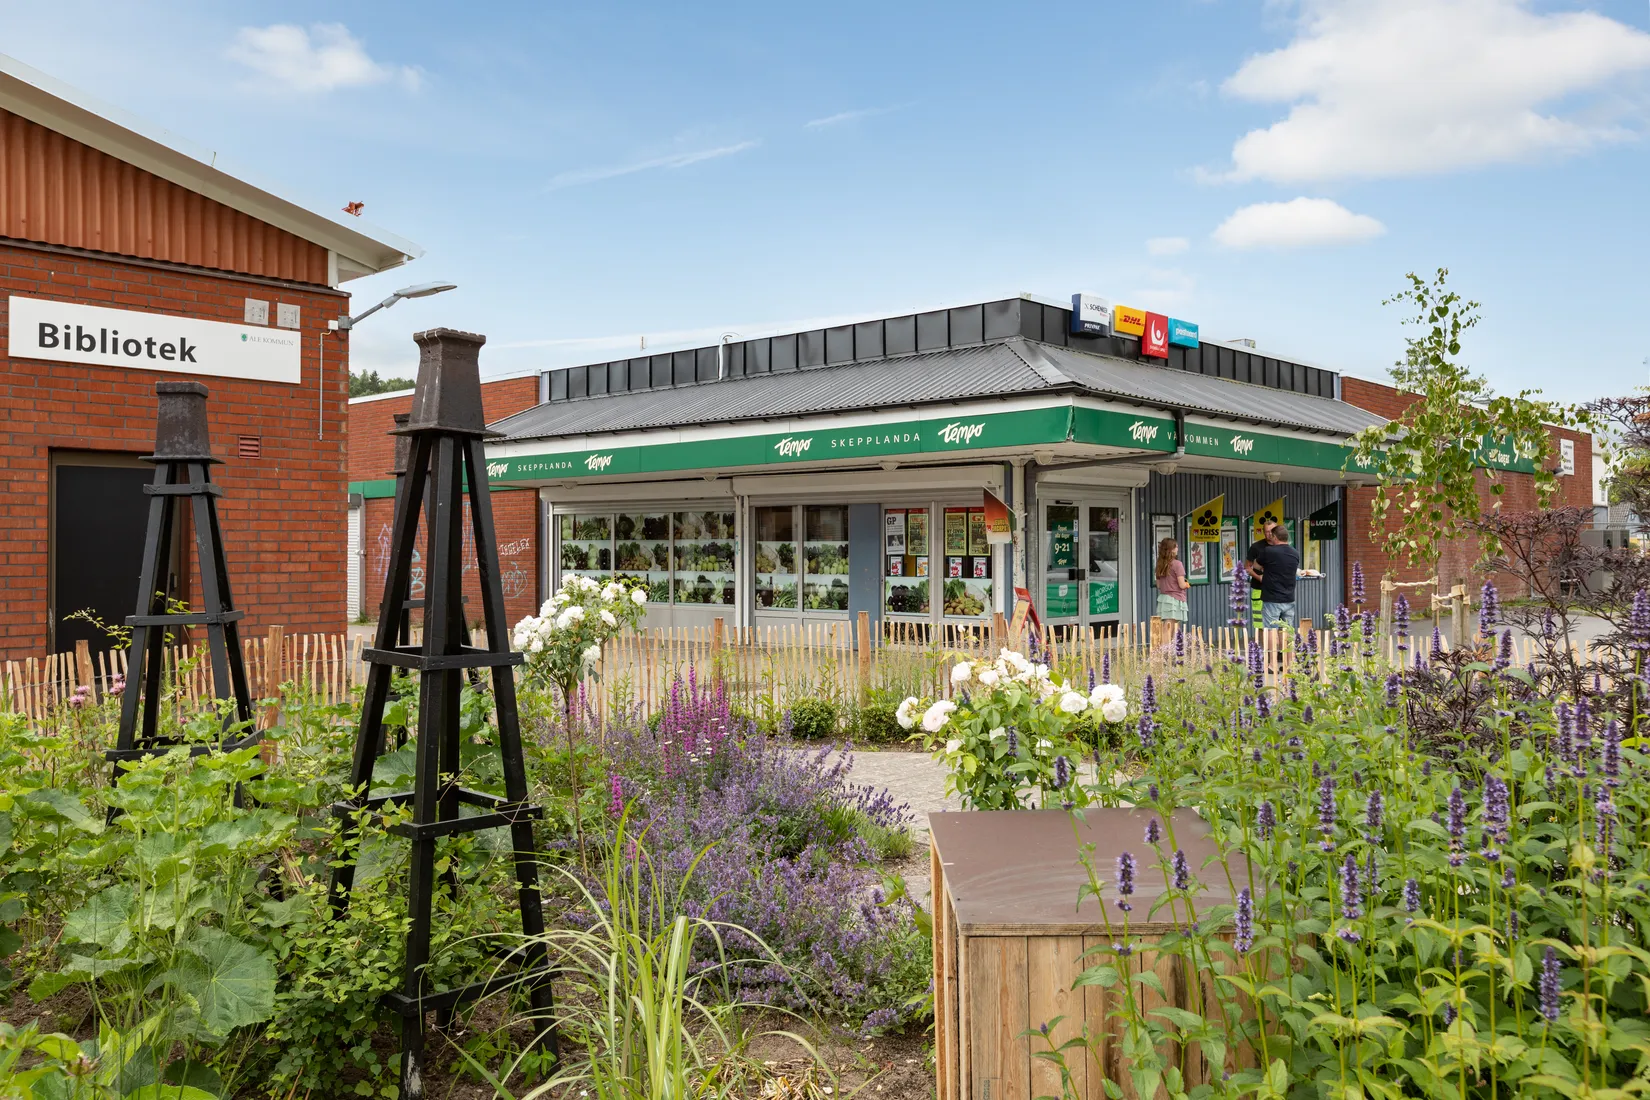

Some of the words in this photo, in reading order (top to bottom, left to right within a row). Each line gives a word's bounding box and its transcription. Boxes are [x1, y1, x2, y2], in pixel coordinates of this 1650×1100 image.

[1123, 314, 1142, 326] DHL
[38, 322, 197, 363] Bibliotek
[249, 335, 262, 343] ALE
[262, 337, 294, 346] KOMMUN
[831, 432, 921, 448] SKEPPLANDA
[937, 421, 986, 444] Tempo
[1128, 421, 1159, 445] Tempo
[1166, 430, 1219, 446] VÄKOMMEN
[774, 437, 813, 457] Tempo
[1230, 435, 1255, 456] Tempo
[486, 461, 510, 478] Tempo
[517, 461, 573, 472] SKEPPLANDA
[584, 453, 613, 471] Tempo
[886, 516, 897, 525] GP
[1315, 519, 1337, 527] LOTTO
[1200, 528, 1220, 536] TRISS
